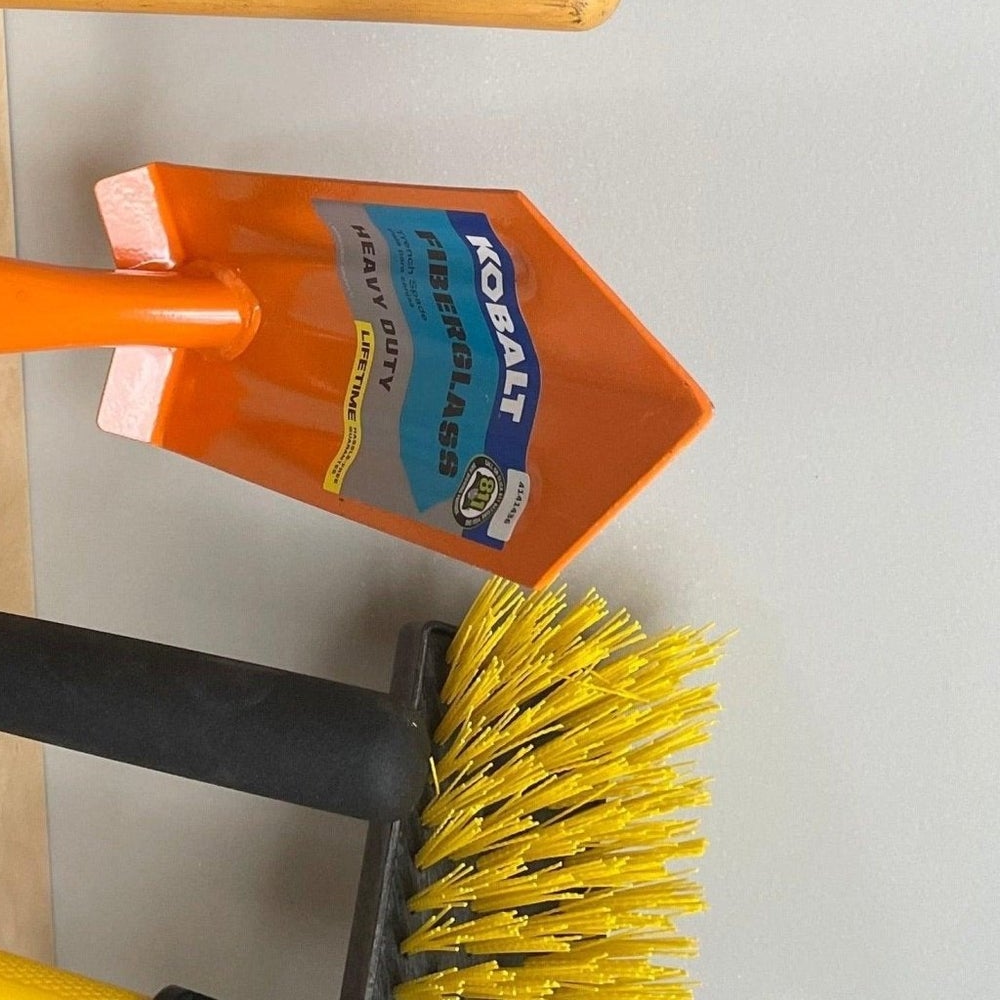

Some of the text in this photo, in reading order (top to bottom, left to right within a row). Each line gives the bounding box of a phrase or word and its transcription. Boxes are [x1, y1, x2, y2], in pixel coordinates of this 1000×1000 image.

[347, 329, 372, 422] LIFETIME
[351, 224, 399, 392] HEAVY DUTY
[415, 230, 472, 478] FIBERGLASS
[465, 235, 528, 423] KOBALT
[470, 477, 496, 511] 811
